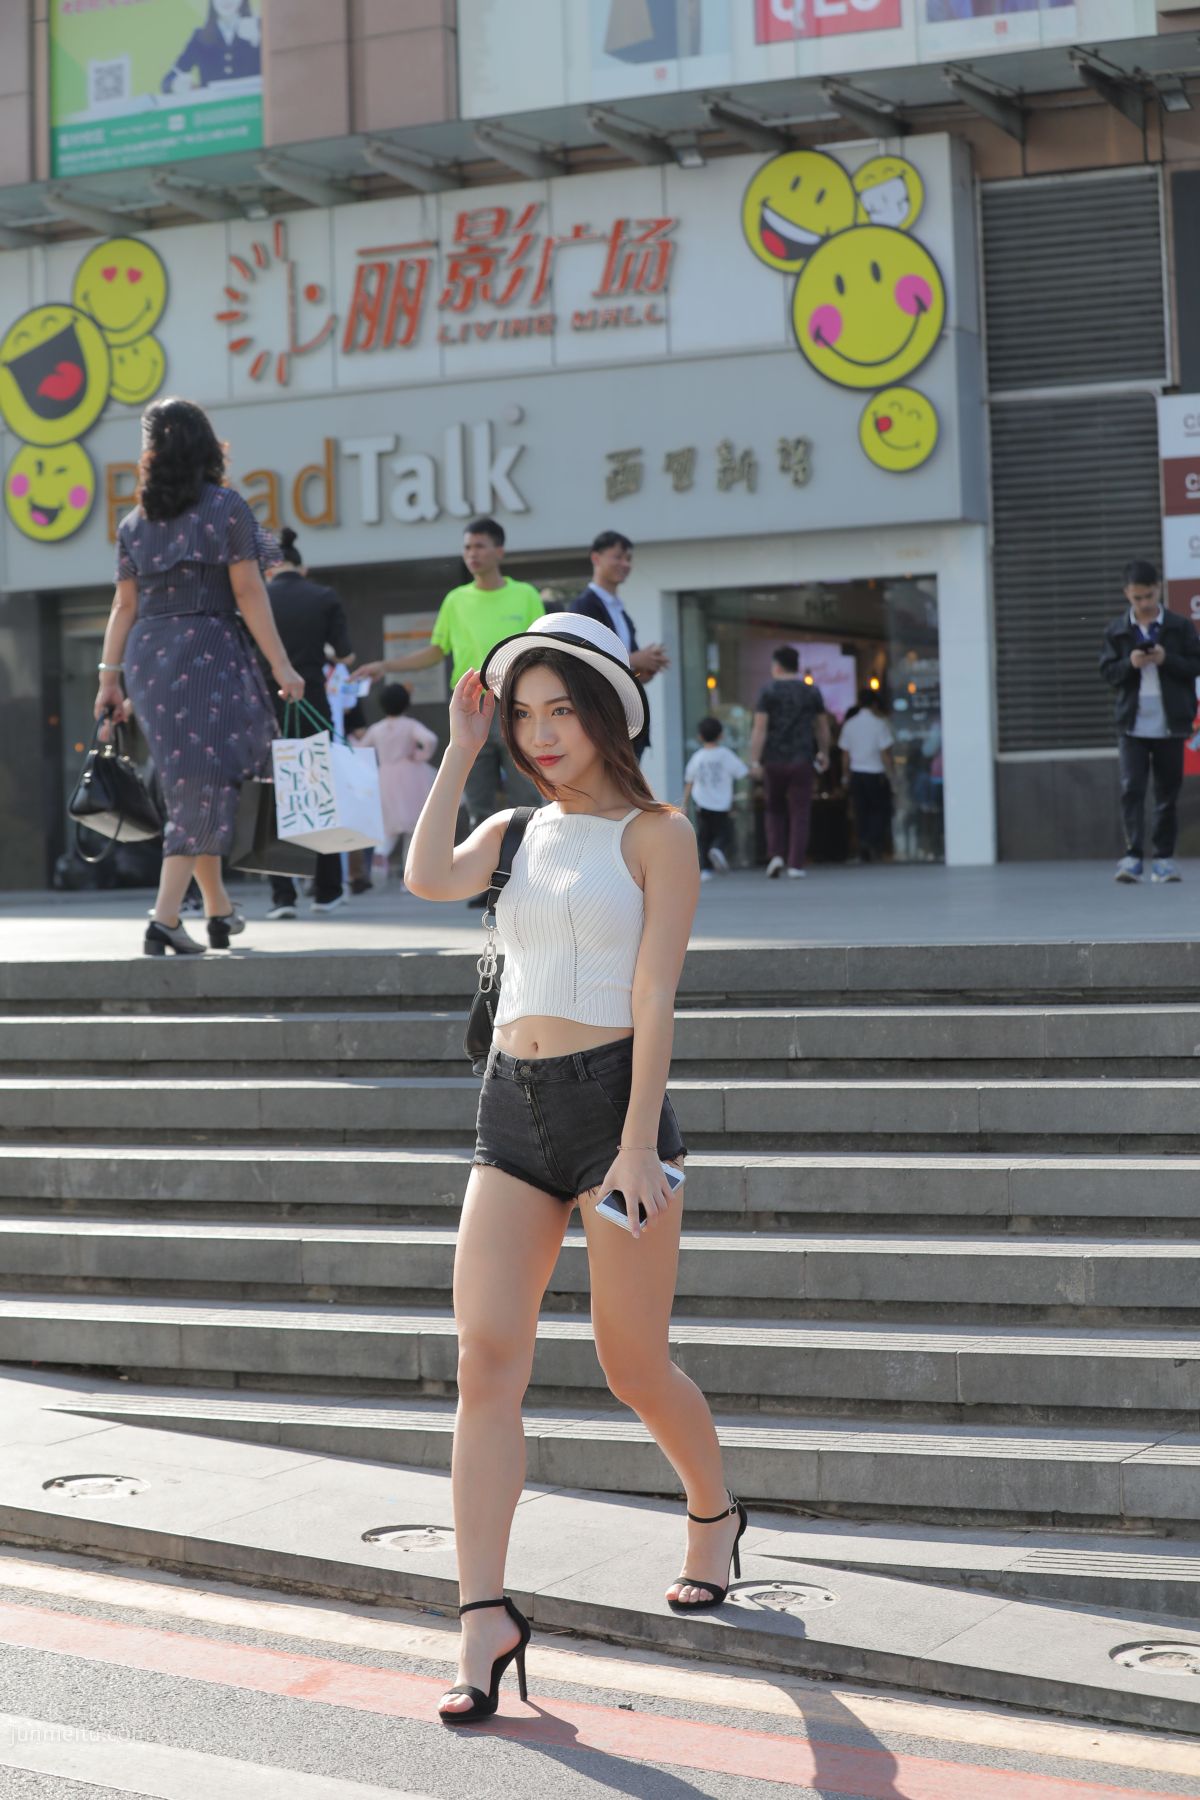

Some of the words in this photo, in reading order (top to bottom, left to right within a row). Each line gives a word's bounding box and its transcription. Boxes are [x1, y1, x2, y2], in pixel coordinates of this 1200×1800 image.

[342, 203, 678, 354] 丽影广场
[437, 313, 557, 346] LIVING
[571, 303, 664, 331] MALL
[106, 420, 529, 544] BadTalk
